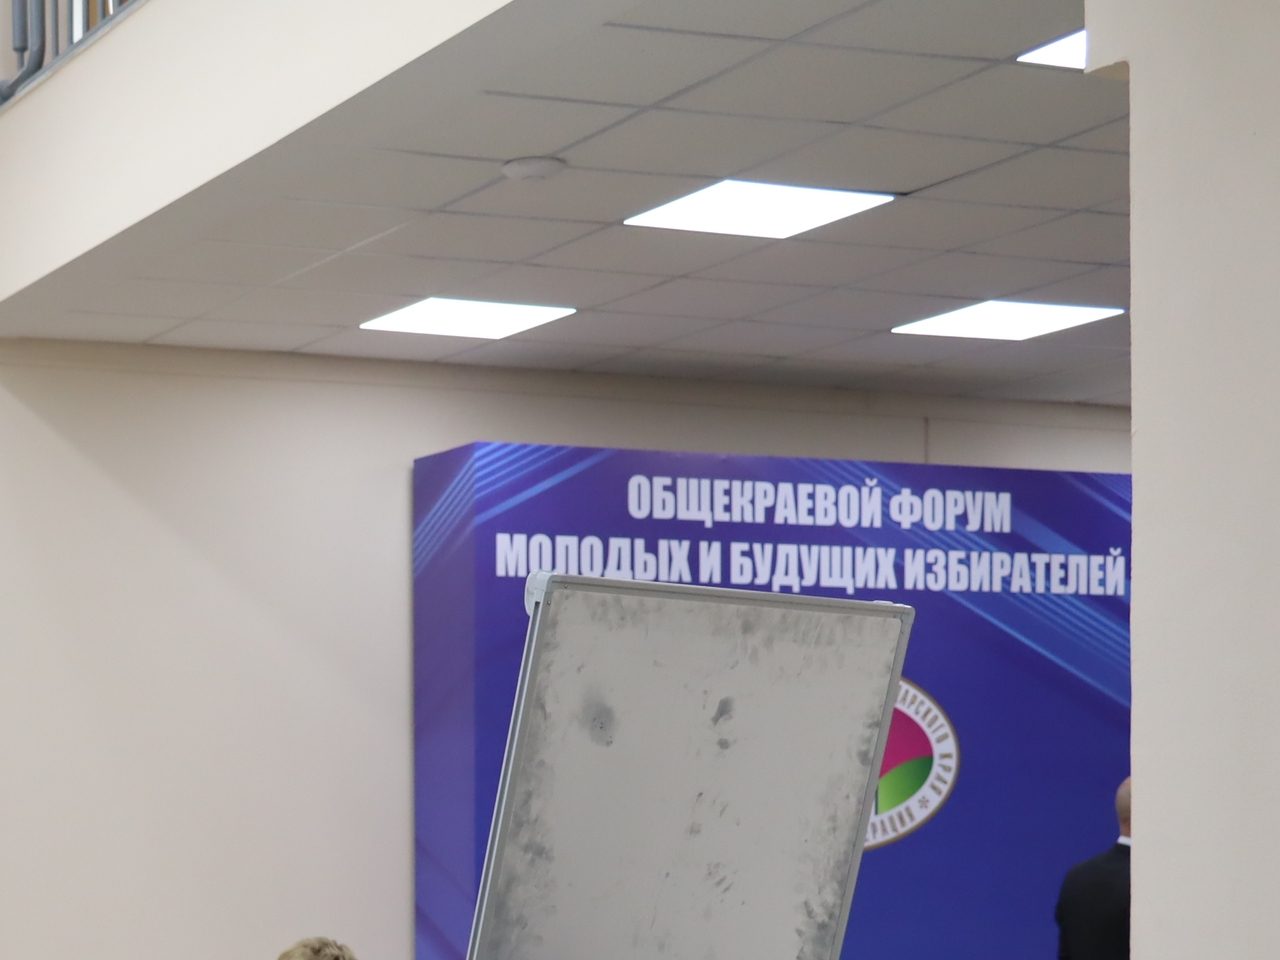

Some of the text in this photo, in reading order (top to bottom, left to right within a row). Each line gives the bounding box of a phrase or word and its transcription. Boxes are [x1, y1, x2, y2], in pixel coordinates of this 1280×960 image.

[627, 474, 1011, 533] ОБЩЕКРАЕВОЙ ФОРУМ
[496, 533, 1125, 596] МОЛОДЫХ И БУДУЩИХ ИЗБИРАТЕЛЕЙ
[899, 686, 949, 744] АРСКОГО
